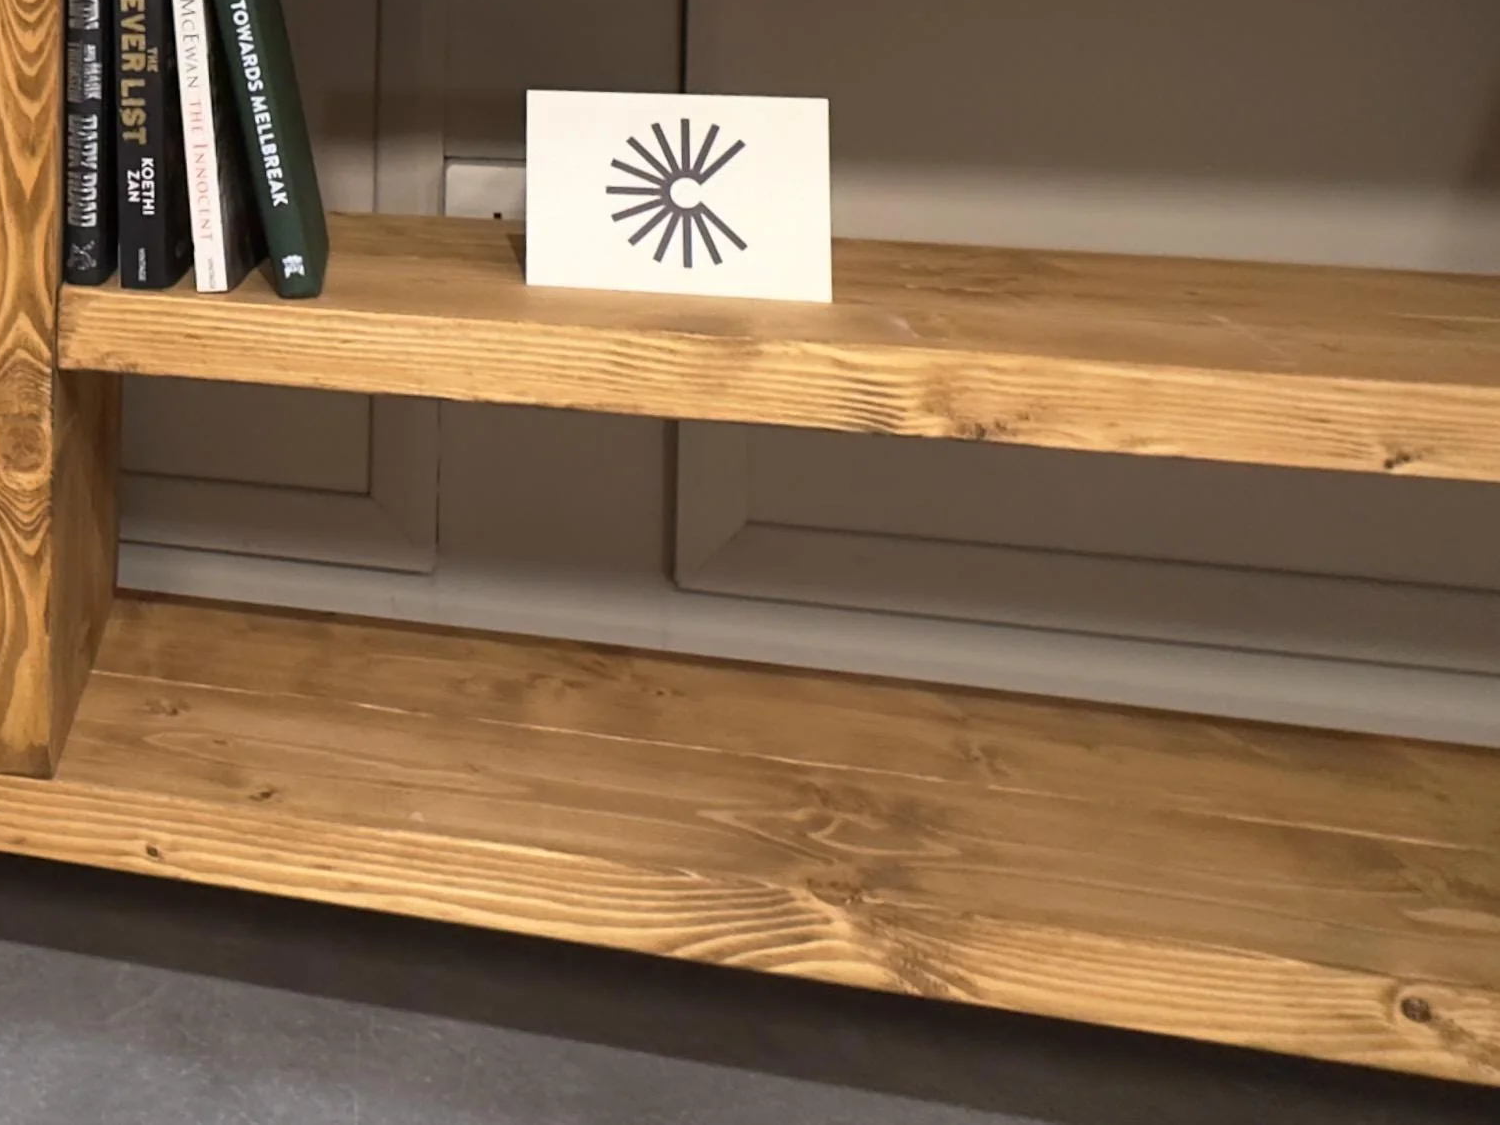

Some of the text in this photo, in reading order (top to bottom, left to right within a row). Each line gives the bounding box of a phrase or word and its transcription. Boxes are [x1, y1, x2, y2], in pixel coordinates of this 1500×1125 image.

[148, 47, 159, 73] THE
[120, 78, 148, 146] LIST
[250, 95, 289, 207] MELLBREAK
[126, 169, 141, 203] ZAN
[141, 157, 156, 216] KOETHI
